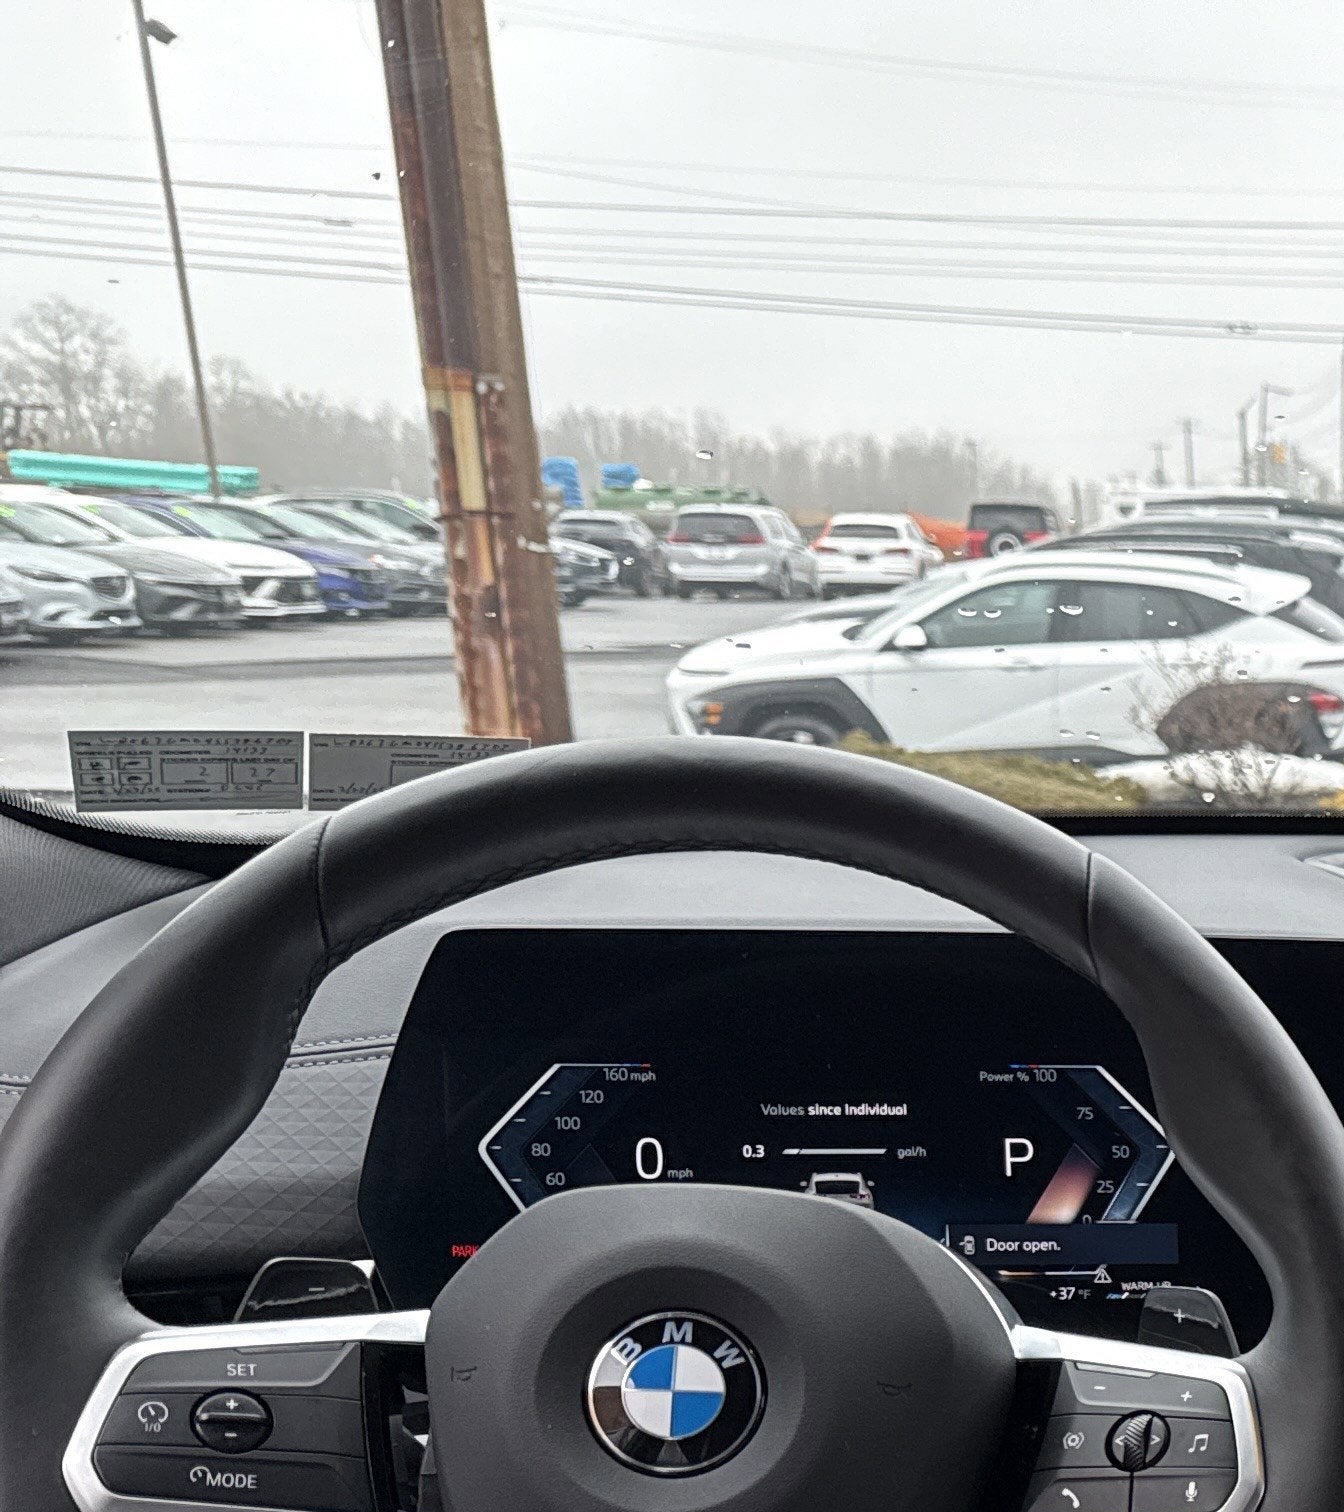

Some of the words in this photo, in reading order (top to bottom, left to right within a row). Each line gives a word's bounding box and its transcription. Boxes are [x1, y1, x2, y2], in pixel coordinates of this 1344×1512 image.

[603, 1067, 628, 1081] 160
[630, 1070, 656, 1083] mph
[979, 1071, 1014, 1083] Power
[1017, 1070, 1029, 1082] %
[1033, 1069, 1057, 1082] 100
[580, 1090, 604, 1104] 120
[761, 1103, 805, 1117] Values
[808, 1103, 841, 1117] since
[1076, 1107, 1093, 1120] 75
[555, 1117, 581, 1130] 100
[531, 1143, 551, 1157] 80
[742, 1144, 765, 1158] 0.3
[897, 1146, 927, 1160] gal/h
[1112, 1146, 1129, 1159] 50
[635, 1137, 663, 1179] 0
[667, 1167, 693, 1180] mph
[1004, 1138, 1033, 1177] P
[546, 1172, 565, 1186] 60
[1097, 1181, 1114, 1194] 25
[986, 1237, 1020, 1252] Door
[1023, 1239, 1061, 1254] open.
[1049, 1287, 1075, 1300] +37
[611, 1321, 746, 1370] BMW
[226, 1363, 257, 1376] SET
[206, 1472, 258, 1488] MODE
